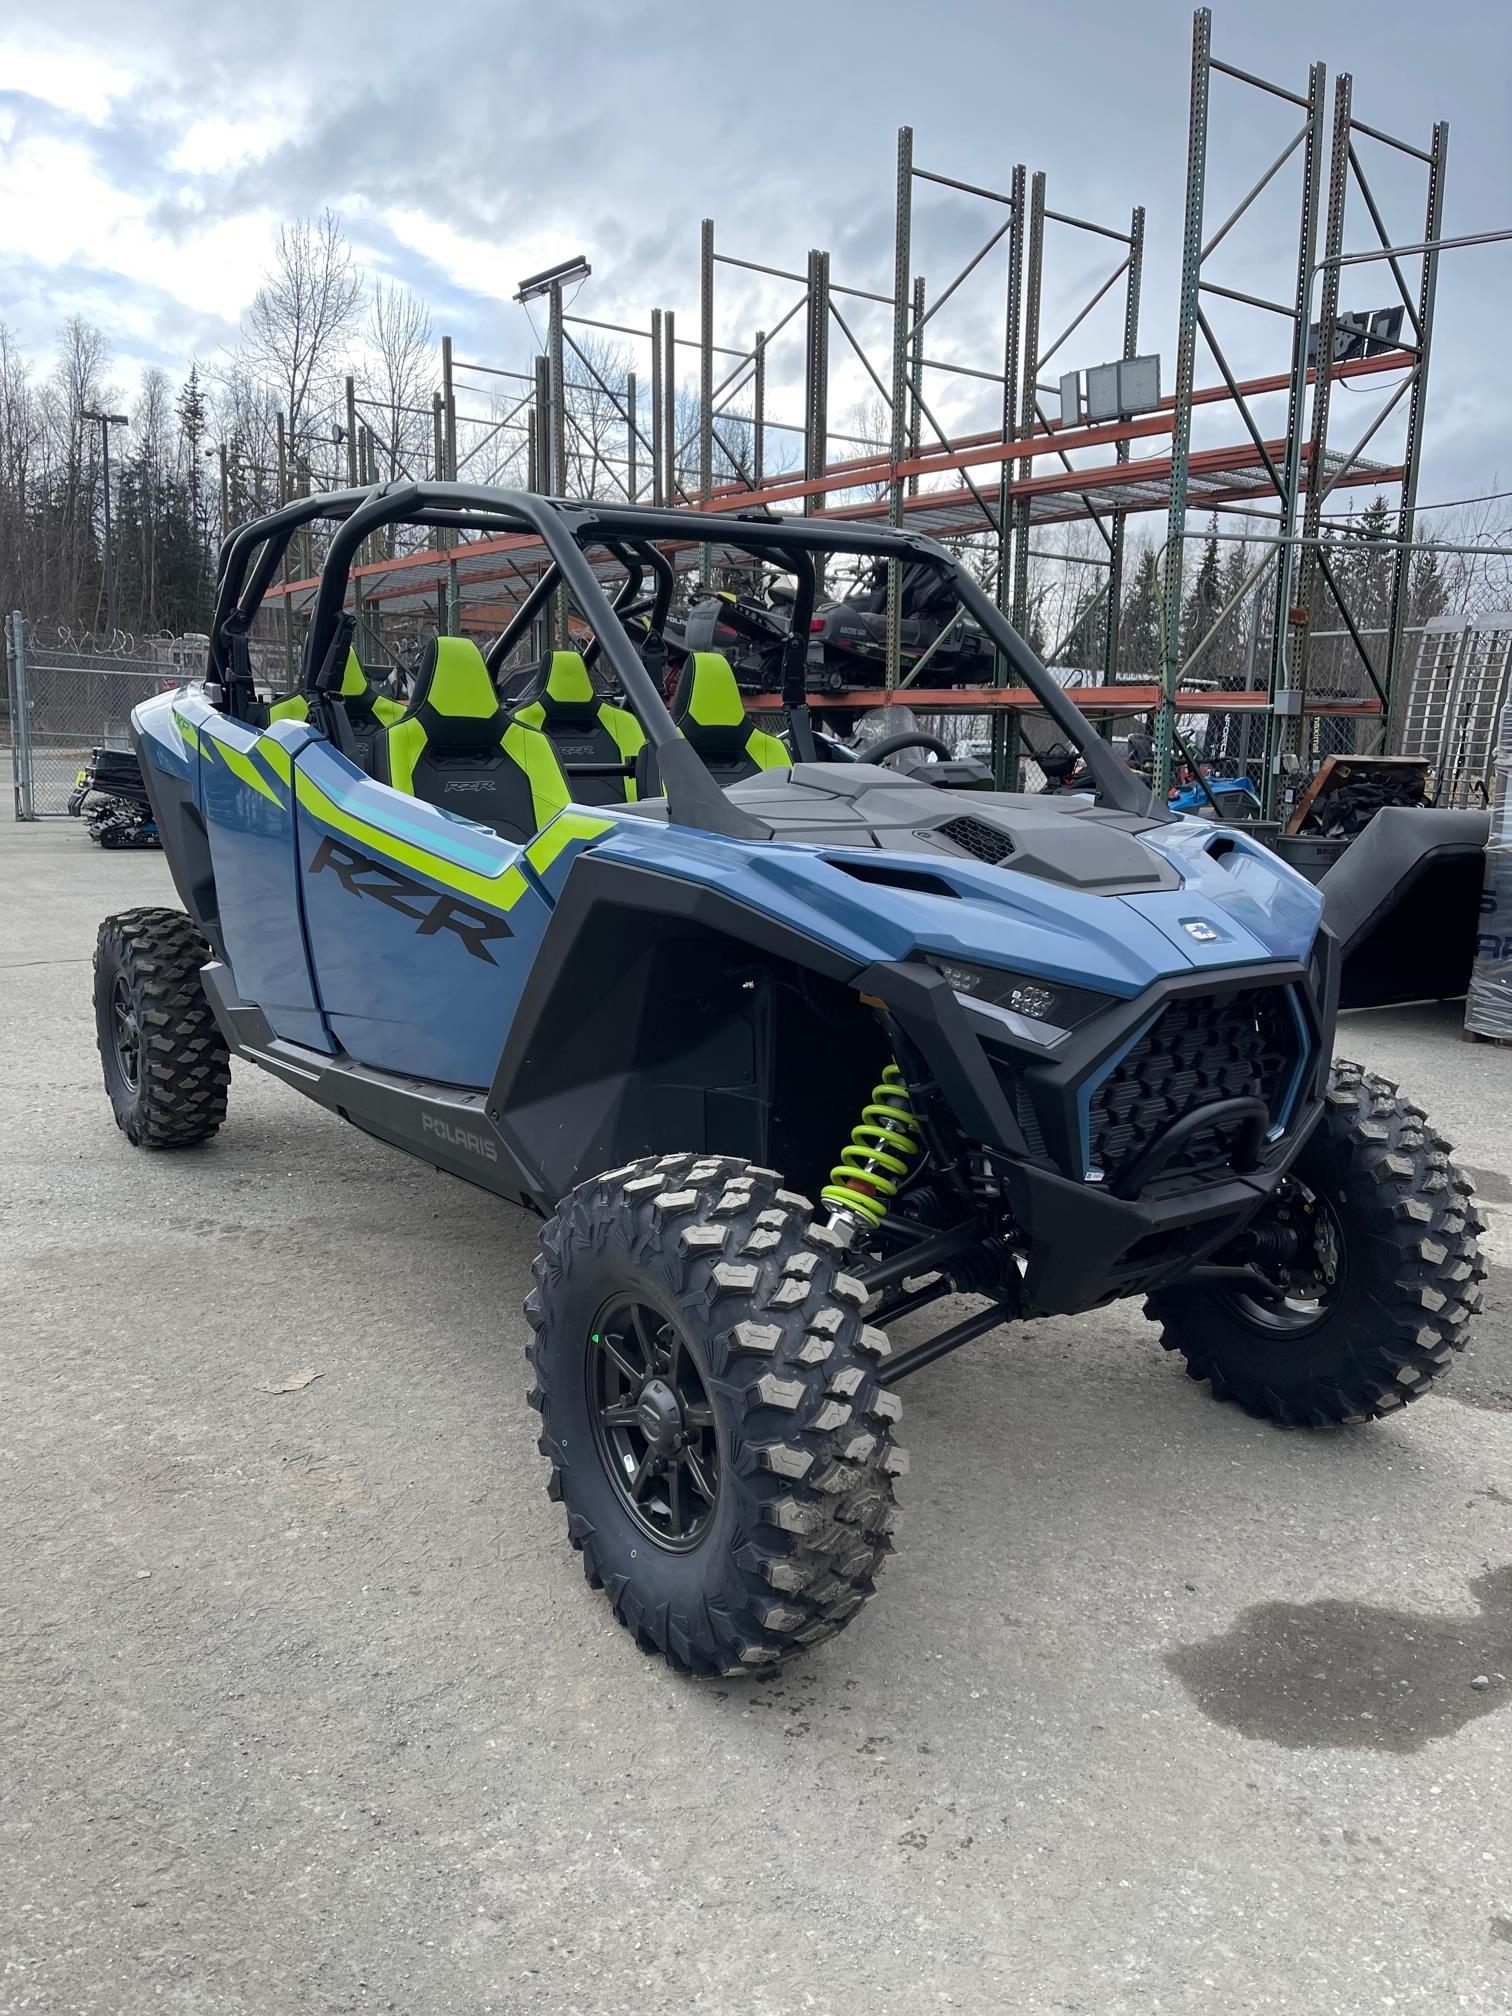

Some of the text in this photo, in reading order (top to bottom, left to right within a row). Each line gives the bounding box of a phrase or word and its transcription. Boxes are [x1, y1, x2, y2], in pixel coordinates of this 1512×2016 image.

[444, 780, 497, 792] RZR
[308, 835, 516, 968] RZR
[422, 1111, 498, 1162] POLARIS
